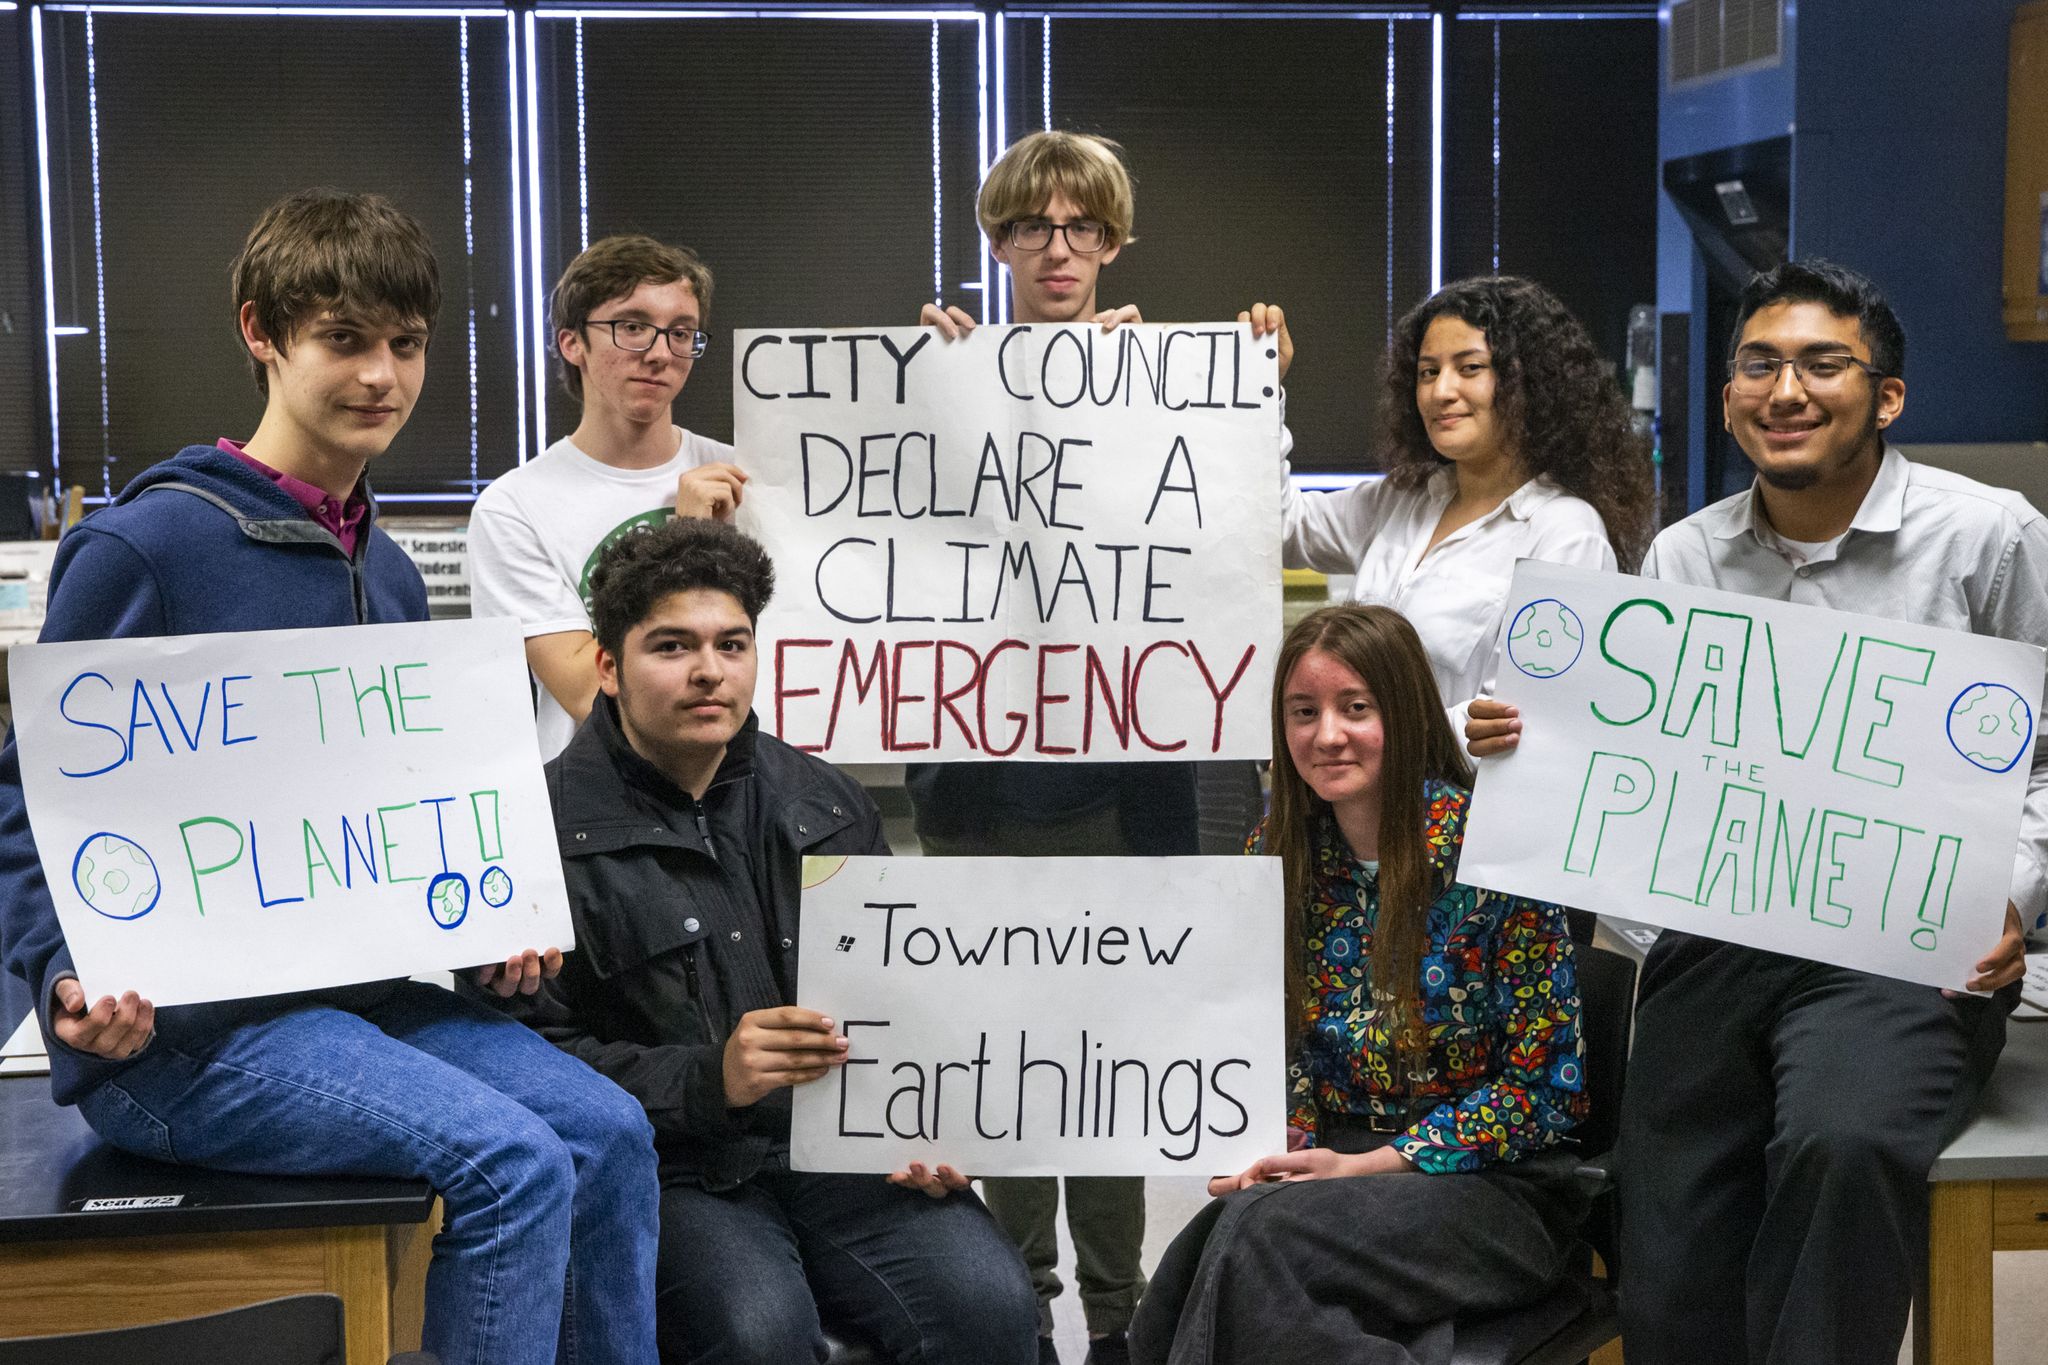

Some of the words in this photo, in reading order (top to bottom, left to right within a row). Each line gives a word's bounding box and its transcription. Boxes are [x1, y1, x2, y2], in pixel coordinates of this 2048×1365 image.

[742, 332, 932, 404] CITY
[998, 325, 1277, 410] COUNCIL:
[801, 431, 1093, 531] DECLARE
[1145, 435, 1202, 529] A
[815, 537, 1192, 623] CLIMATE
[59, 671, 258, 778] SAVE
[283, 662, 444, 744] THE
[775, 638, 1256, 757] EMERGENCY
[1590, 598, 1936, 788] SAVE
[1702, 754, 1765, 783] THE
[179, 790, 515, 930] PLANET!
[1563, 751, 1963, 951] PLANET!
[863, 902, 1193, 967] Townview
[838, 1020, 1252, 1162] Earthlings
